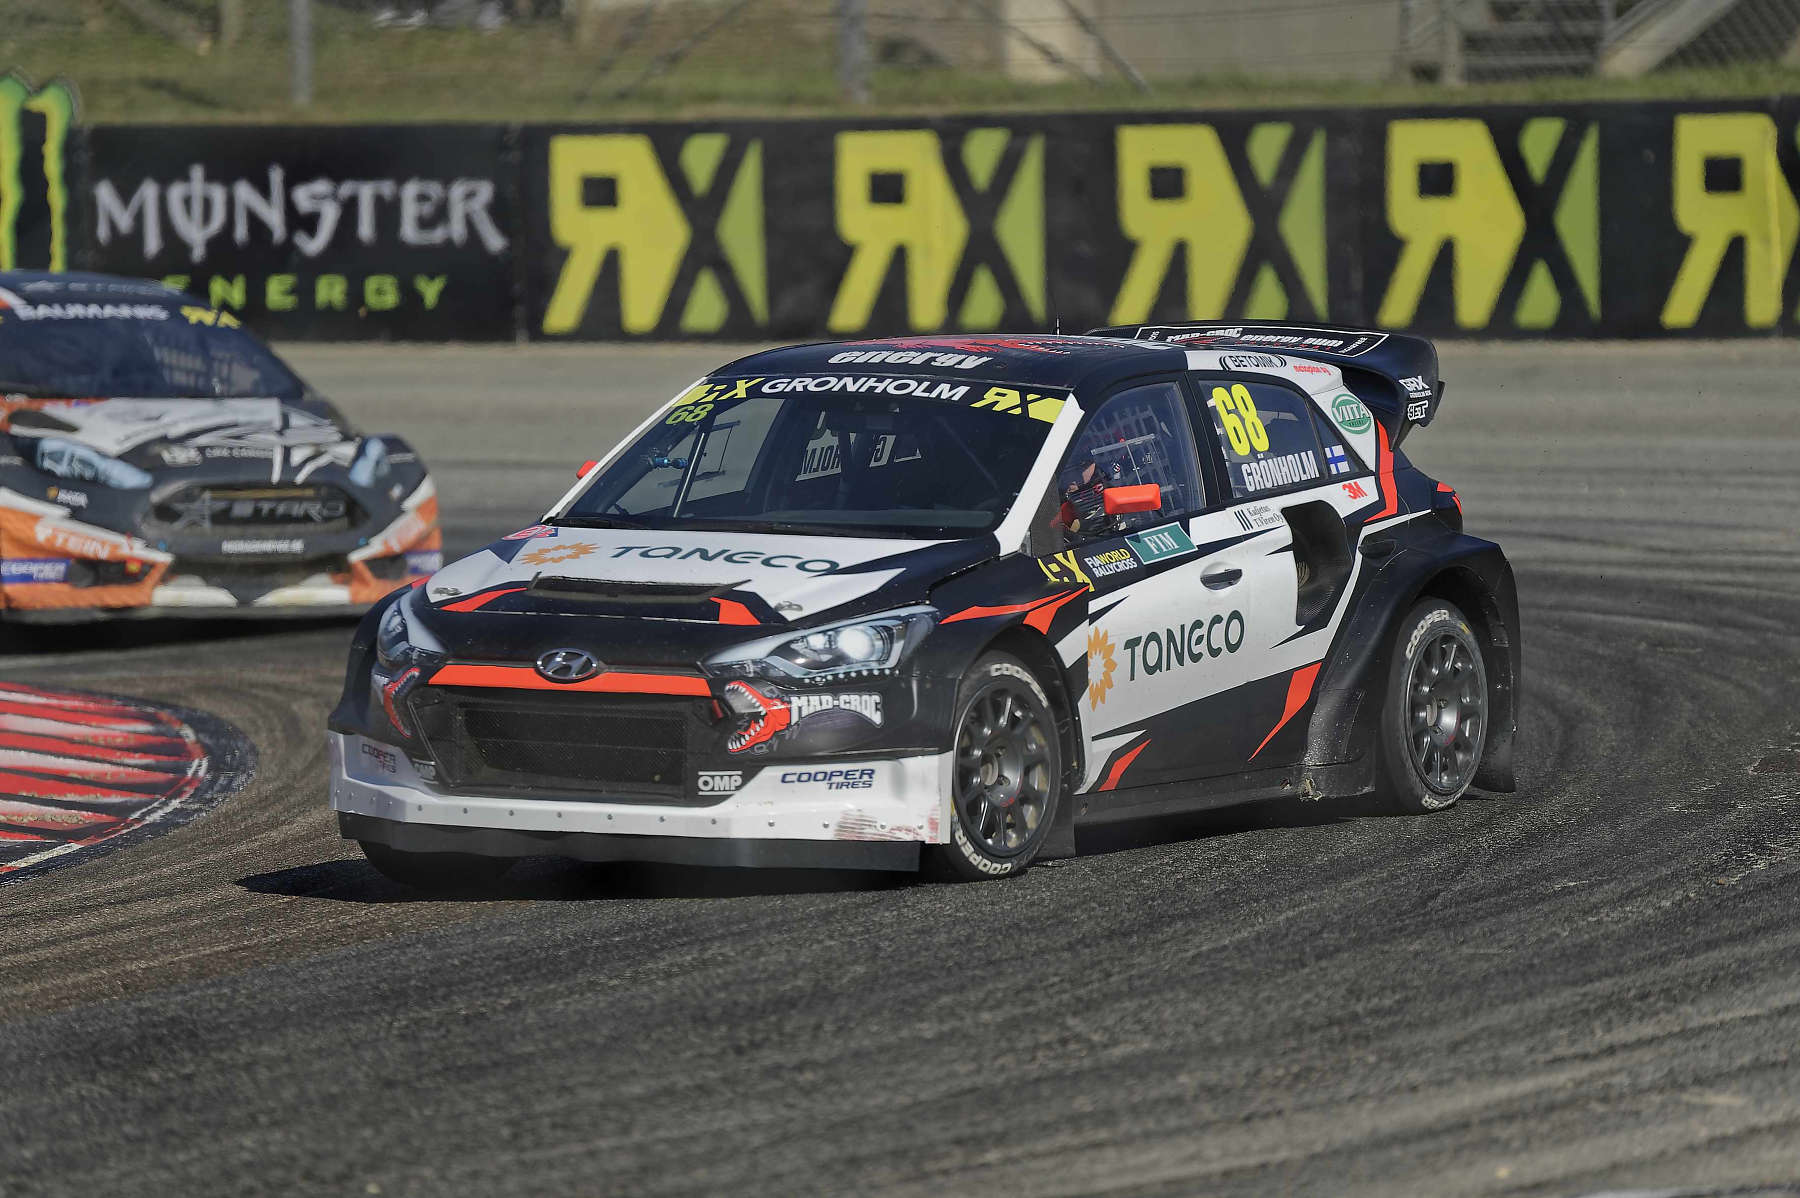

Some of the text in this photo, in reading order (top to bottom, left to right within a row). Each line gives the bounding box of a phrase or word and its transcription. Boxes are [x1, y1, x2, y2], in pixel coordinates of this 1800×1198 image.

[95, 163, 508, 263] MONSTER
[827, 351, 994, 369] energy
[1229, 355, 1279, 368] BETOMIK
[761, 376, 970, 400] GRONHOLM
[665, 403, 715, 425] 68
[1212, 383, 1270, 456] 68
[1241, 450, 1320, 492] GRÖNHOLM
[1341, 481, 1369, 500] 3M
[1143, 531, 1181, 555] FIM
[610, 545, 840, 574] TANECO
[1092, 558, 1138, 577] RALLYCROSS
[1123, 609, 1246, 682] TANECO
[790, 694, 883, 726] MAD-CROC
[698, 775, 743, 791] OMP
[781, 768, 875, 784] COOPER
[826, 780, 872, 790] TIRES
